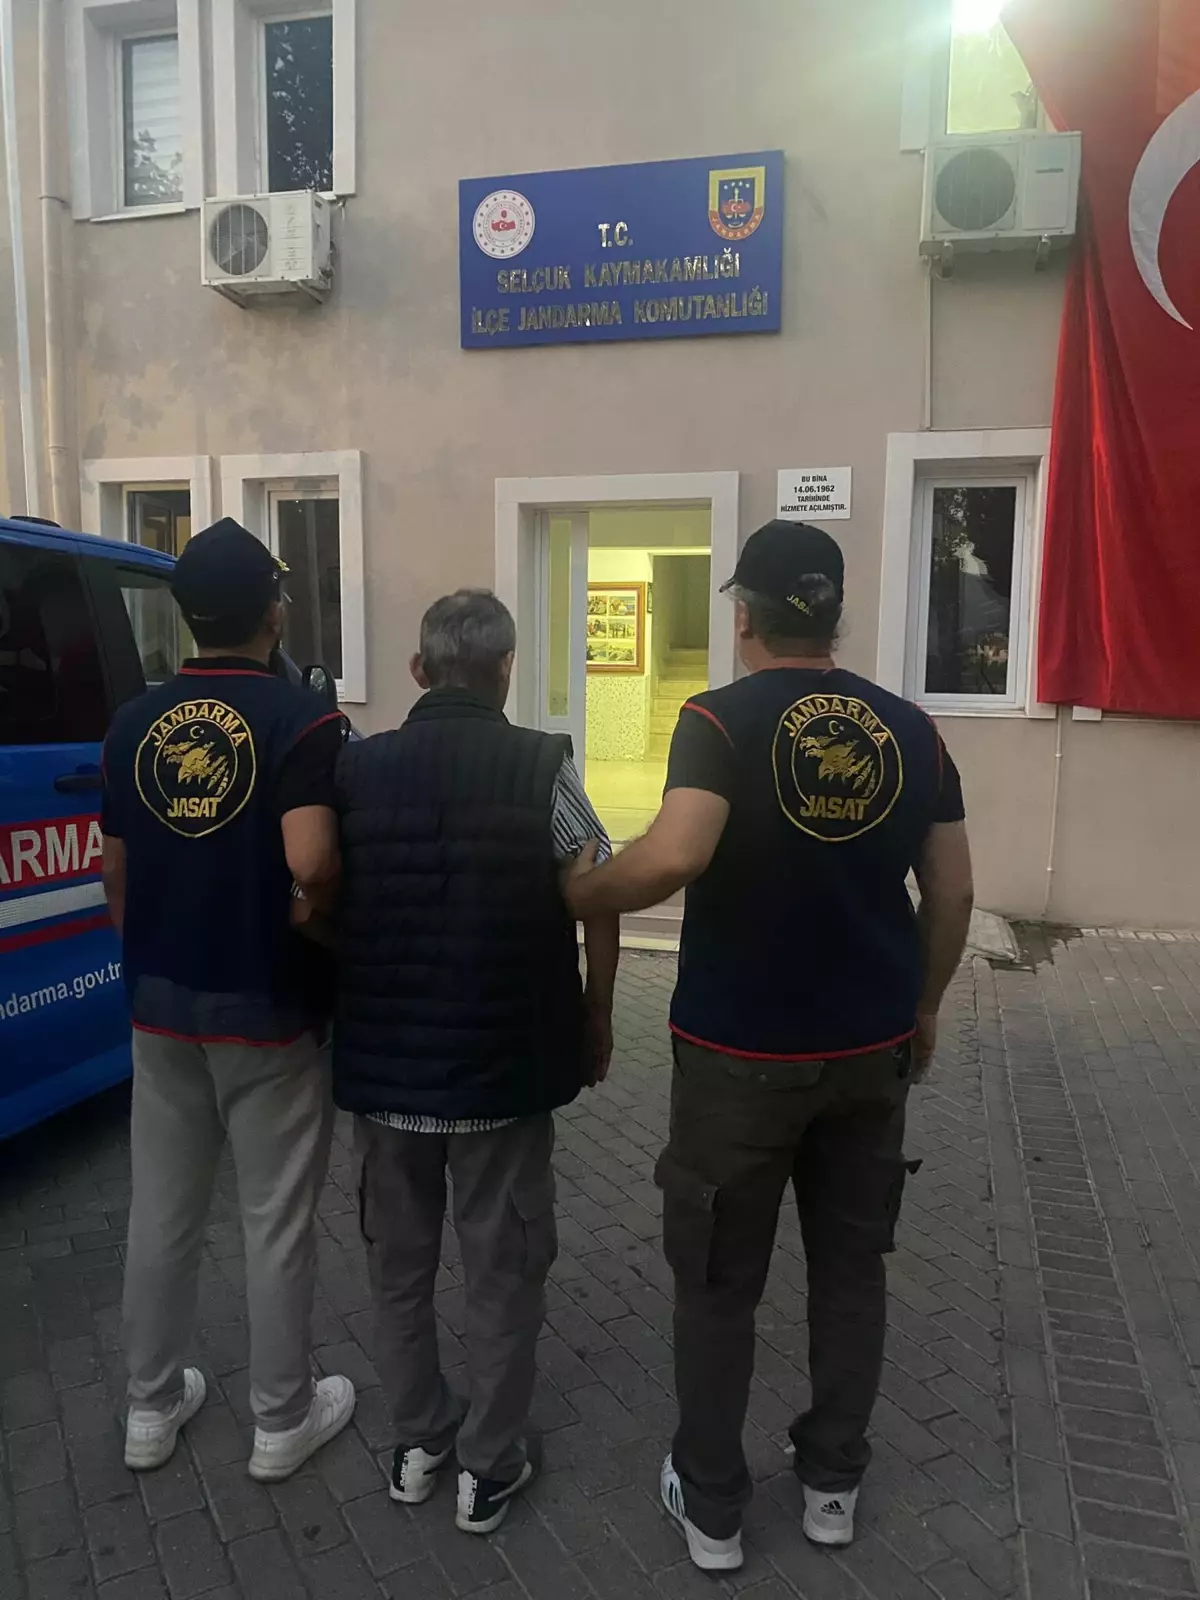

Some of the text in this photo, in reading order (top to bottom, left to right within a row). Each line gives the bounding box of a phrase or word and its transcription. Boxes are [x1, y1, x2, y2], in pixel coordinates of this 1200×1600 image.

[598, 221, 633, 248] T.C.
[497, 247, 740, 294] SELÇUK KAYMAKAMLIĞI
[471, 285, 768, 336] İLÇE JANDARMA KOMUTANLIĞI
[793, 485, 835, 493] 14.06.1962
[812, 474, 828, 482] BİNA
[780, 504, 847, 513] HİZMETE AÇILMIŞTIR.
[797, 494, 831, 502] TARİHİNDE
[786, 594, 813, 617] JASA
[151, 703, 248, 747] JANDARMA
[784, 698, 890, 747] JANDARMA
[167, 797, 222, 818] JASAT
[800, 795, 870, 820] JASAT
